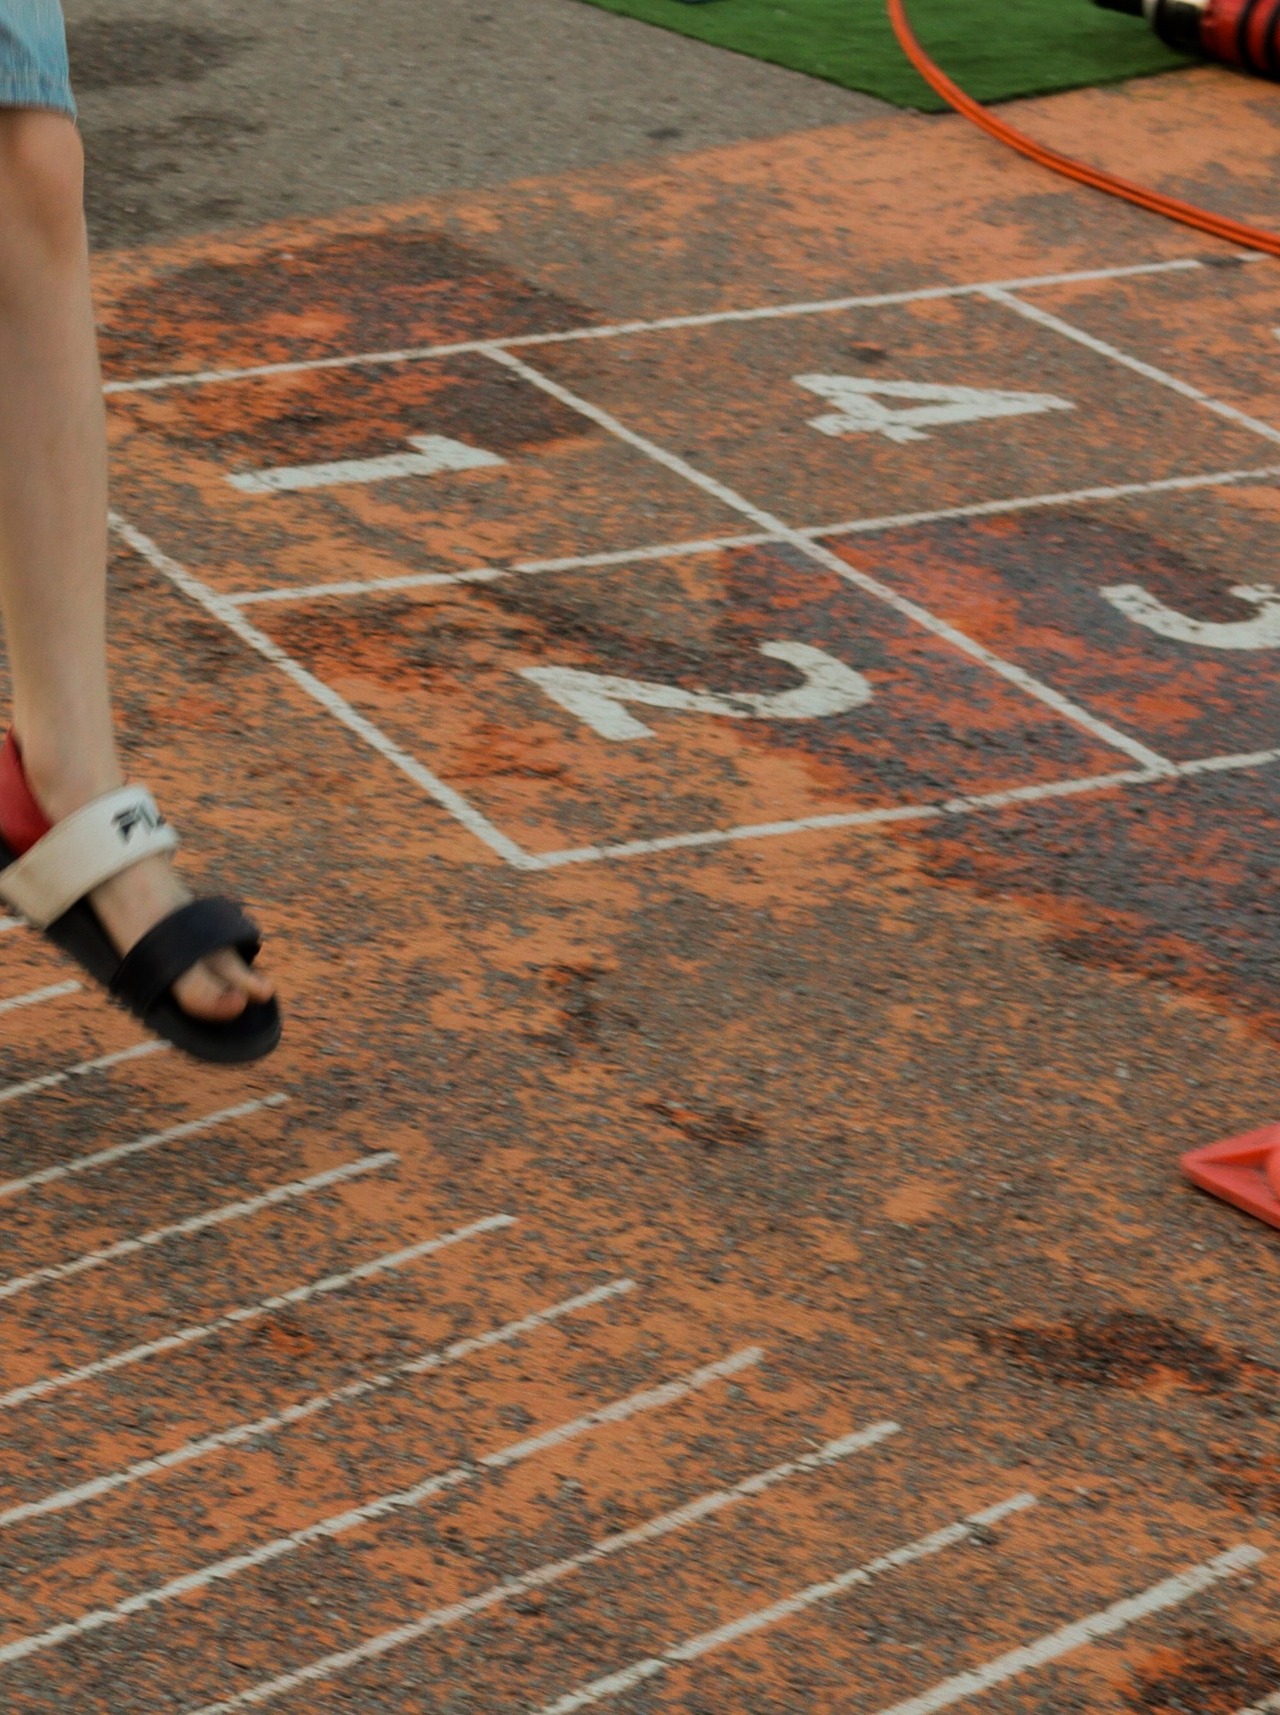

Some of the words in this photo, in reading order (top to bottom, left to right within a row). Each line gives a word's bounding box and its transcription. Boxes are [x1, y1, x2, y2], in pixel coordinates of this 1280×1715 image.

[791, 373, 1076, 444] 4
[226, 434, 508, 493] 1
[520, 640, 874, 742] 2
